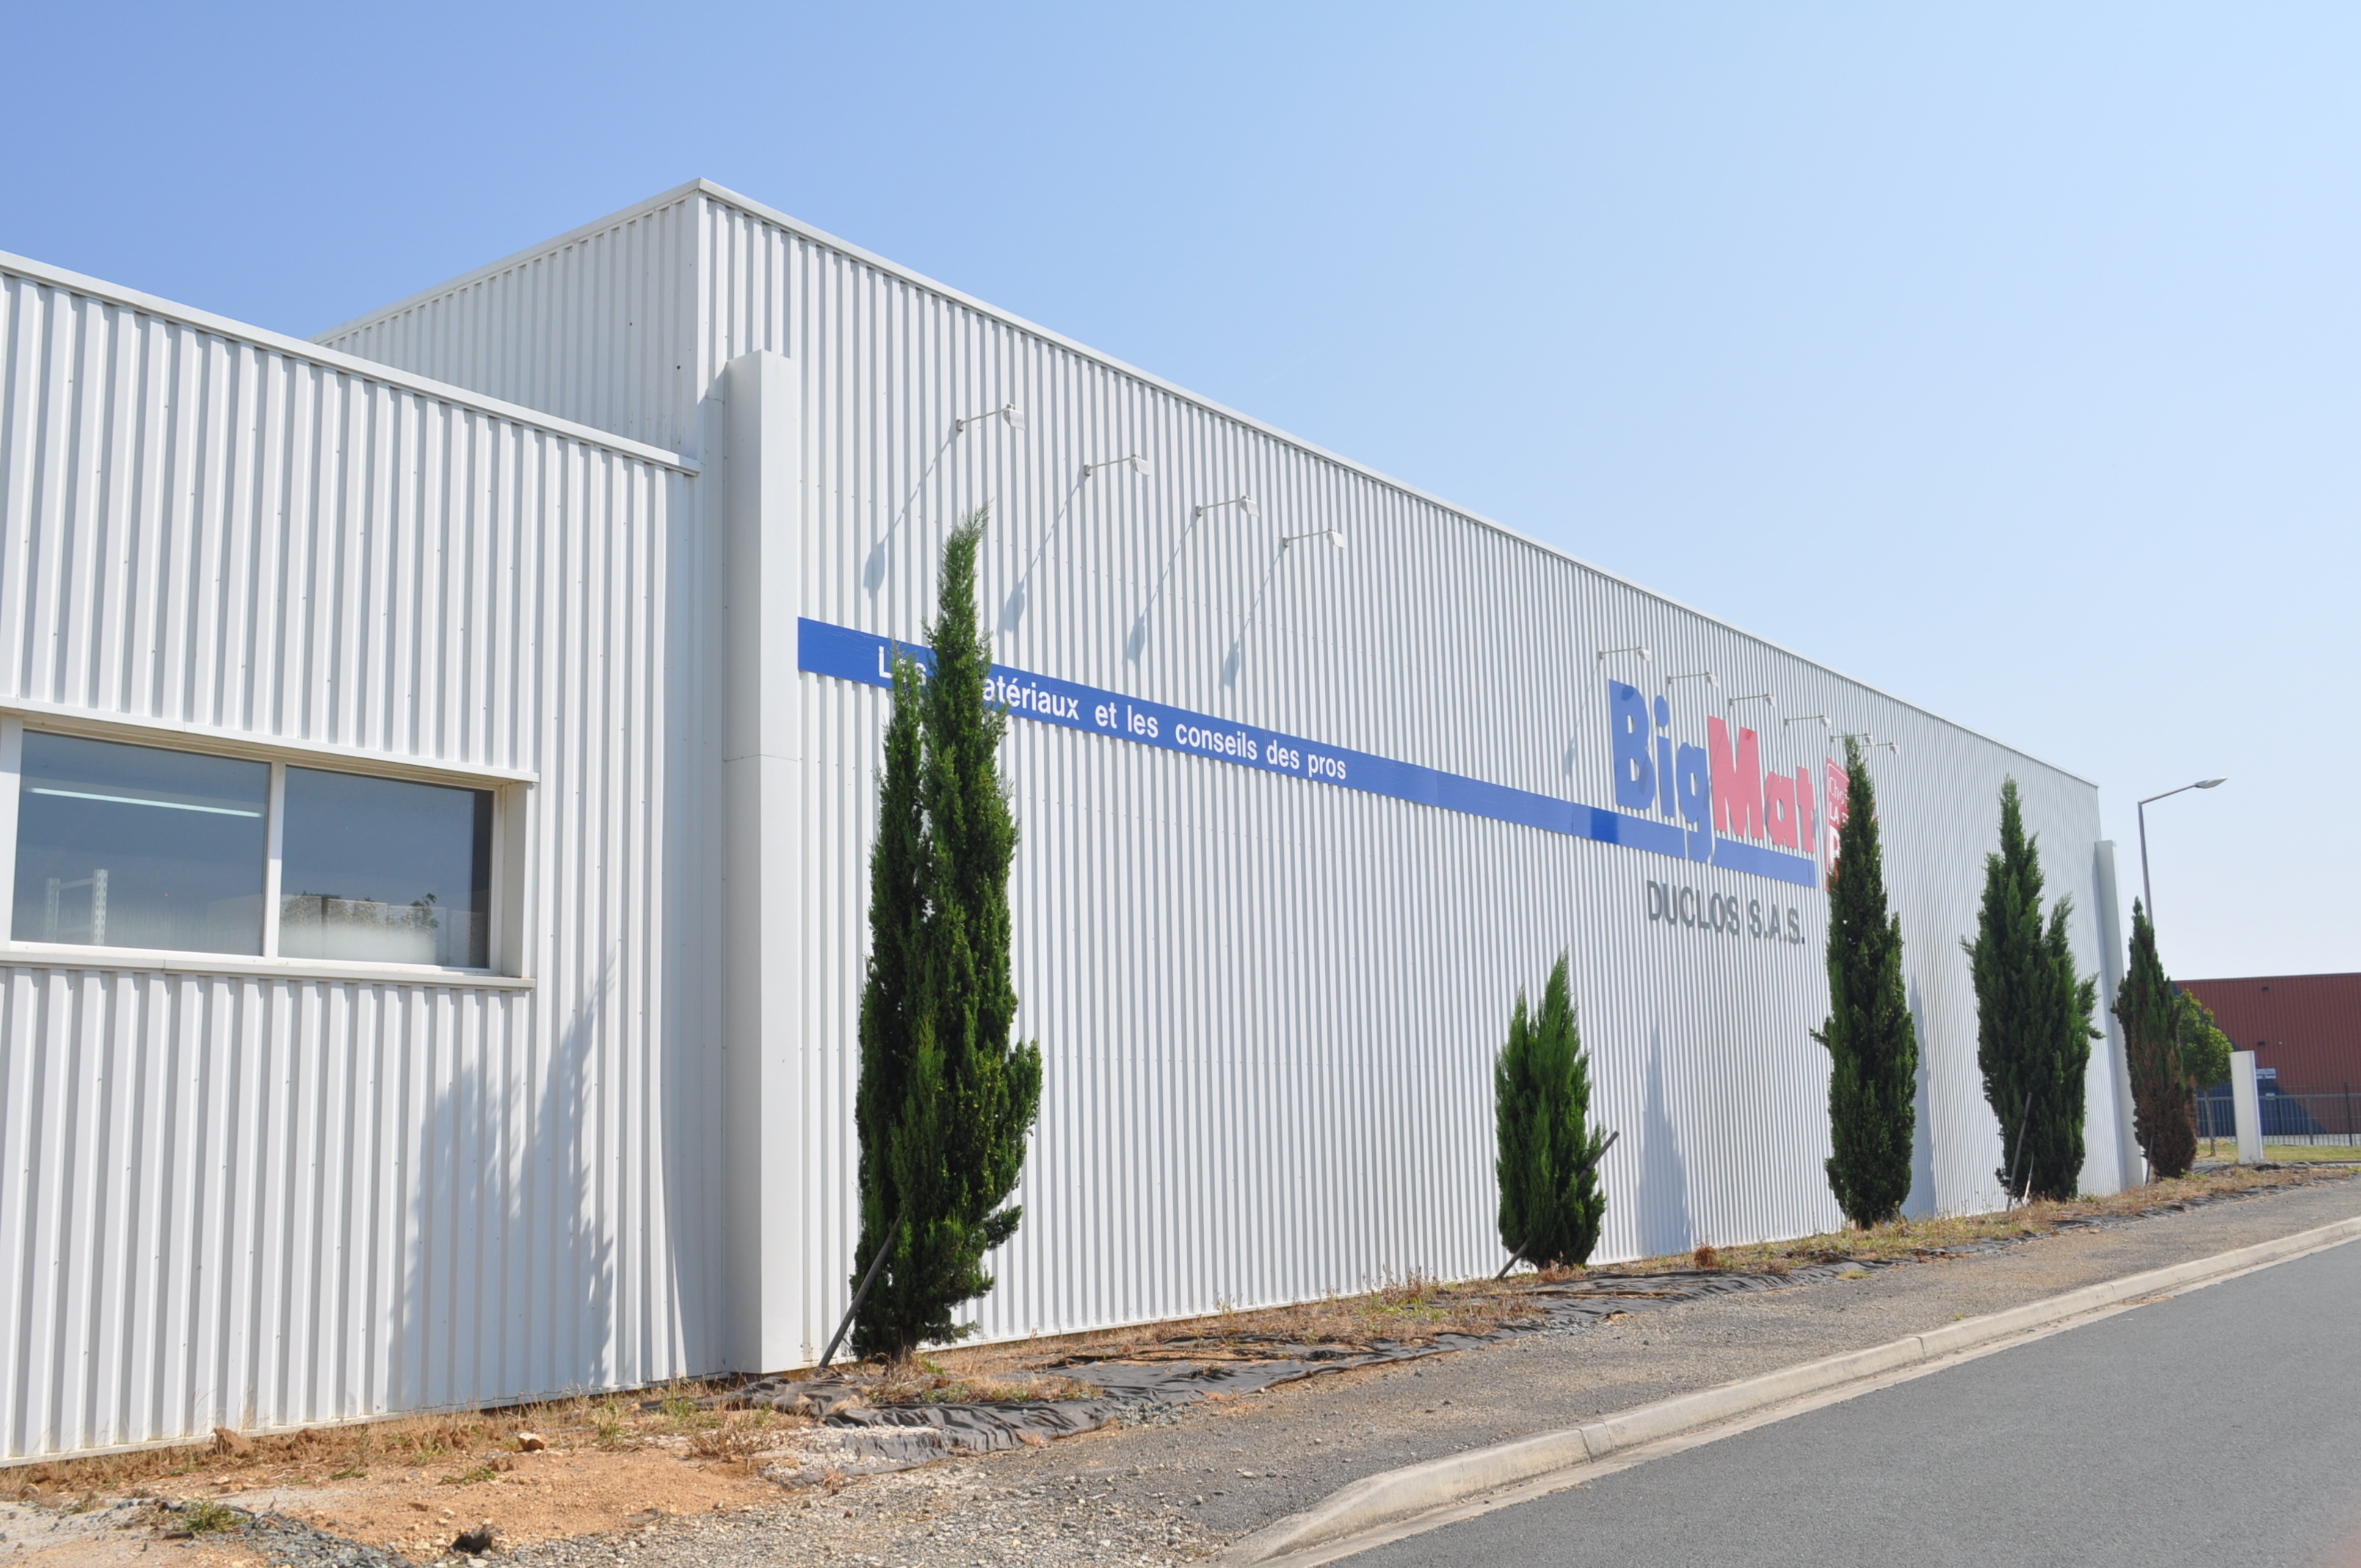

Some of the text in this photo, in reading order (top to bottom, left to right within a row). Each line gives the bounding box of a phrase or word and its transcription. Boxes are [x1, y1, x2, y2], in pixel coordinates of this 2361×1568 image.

[982, 674, 1080, 720] atériaux
[1095, 702, 1117, 728] et
[1127, 705, 1158, 738] les
[1175, 723, 1258, 761] conseils
[1266, 739, 1299, 769] des
[1308, 753, 1346, 780] pros
[1609, 678, 1815, 864] BigMat
[1647, 879, 1805, 945] DUCLOS S.A.S.
